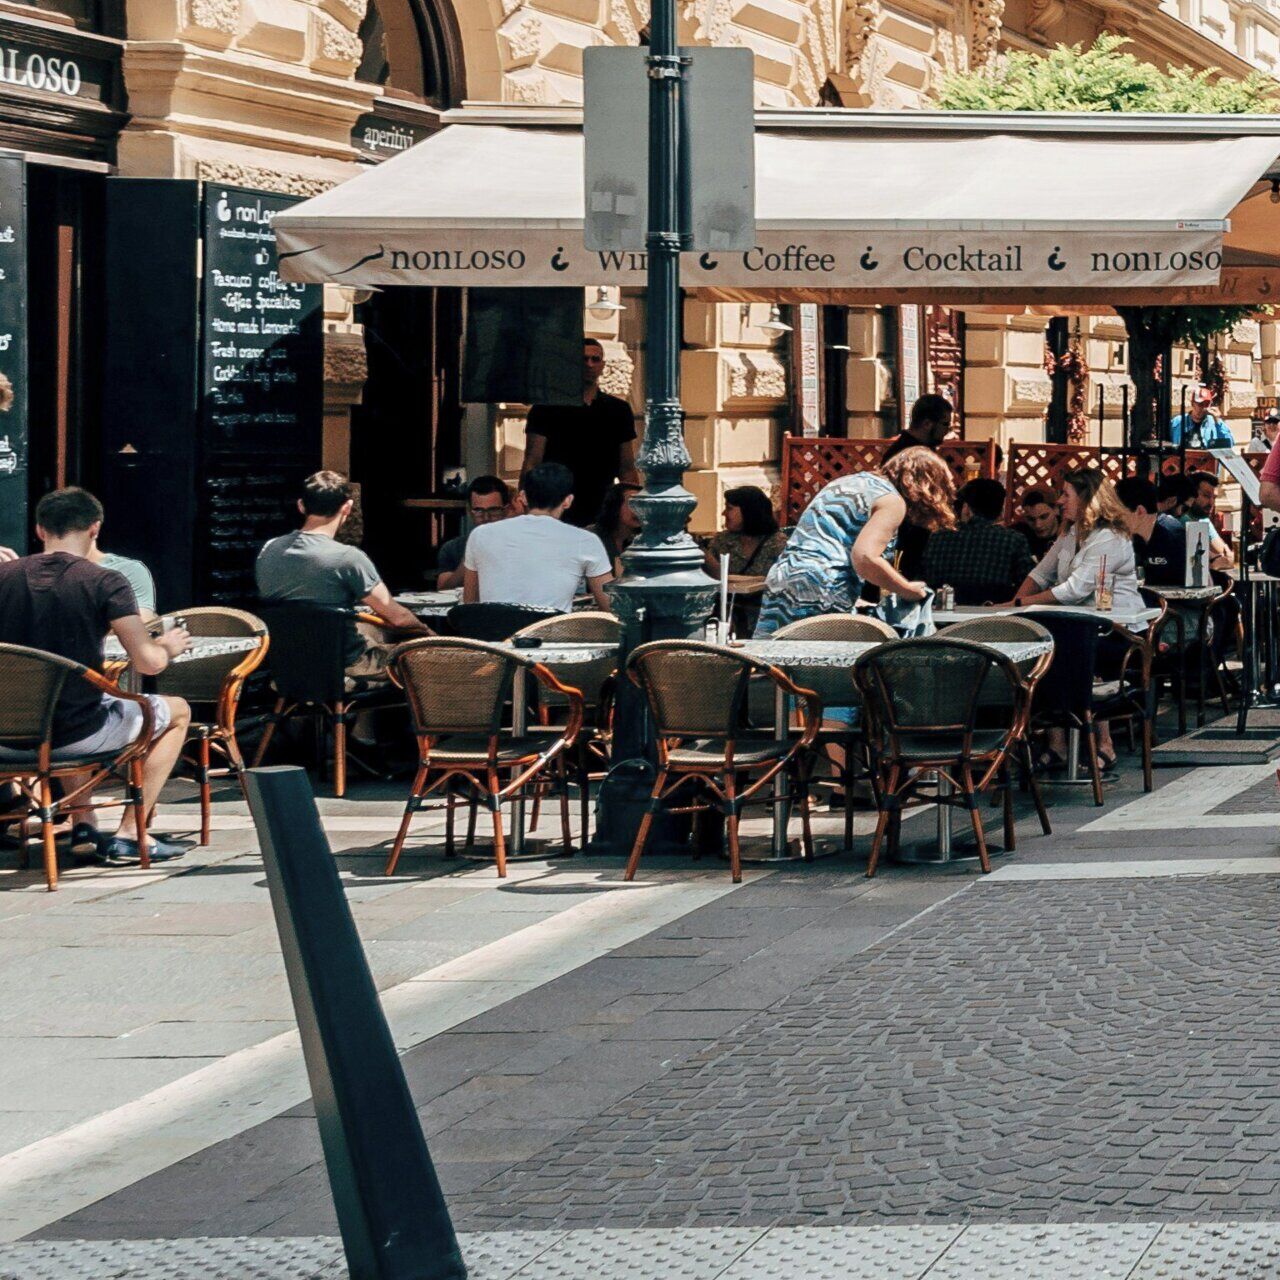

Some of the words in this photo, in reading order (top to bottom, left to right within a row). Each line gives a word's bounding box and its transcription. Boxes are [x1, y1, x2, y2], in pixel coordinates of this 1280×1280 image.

[0, 46, 81, 95] LOSO
[743, 245, 836, 271] Coffee
[903, 245, 1022, 271] Cocktail
